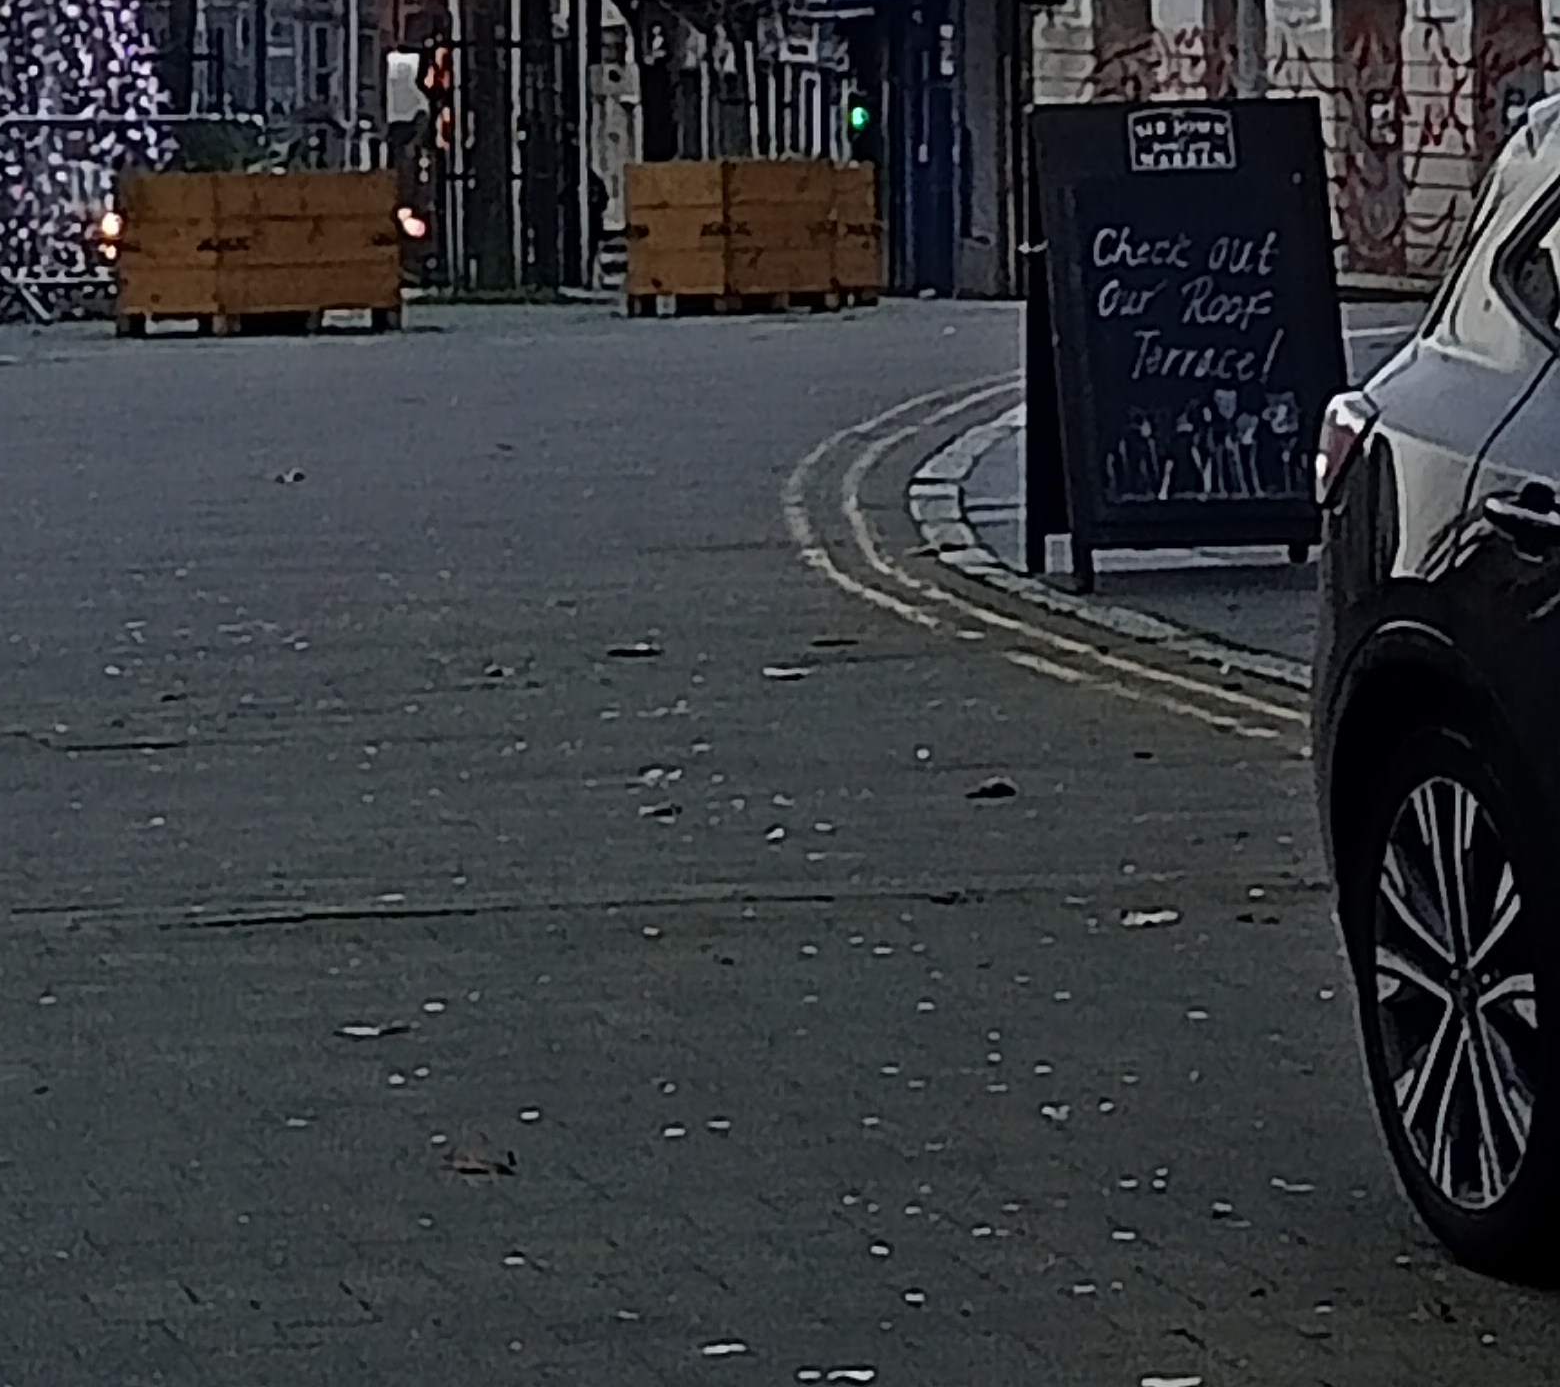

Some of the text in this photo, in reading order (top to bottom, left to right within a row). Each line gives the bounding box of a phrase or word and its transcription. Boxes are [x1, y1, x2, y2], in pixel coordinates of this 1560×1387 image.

[1093, 227, 1279, 276] Check out
[1180, 276, 1273, 331] Roof
